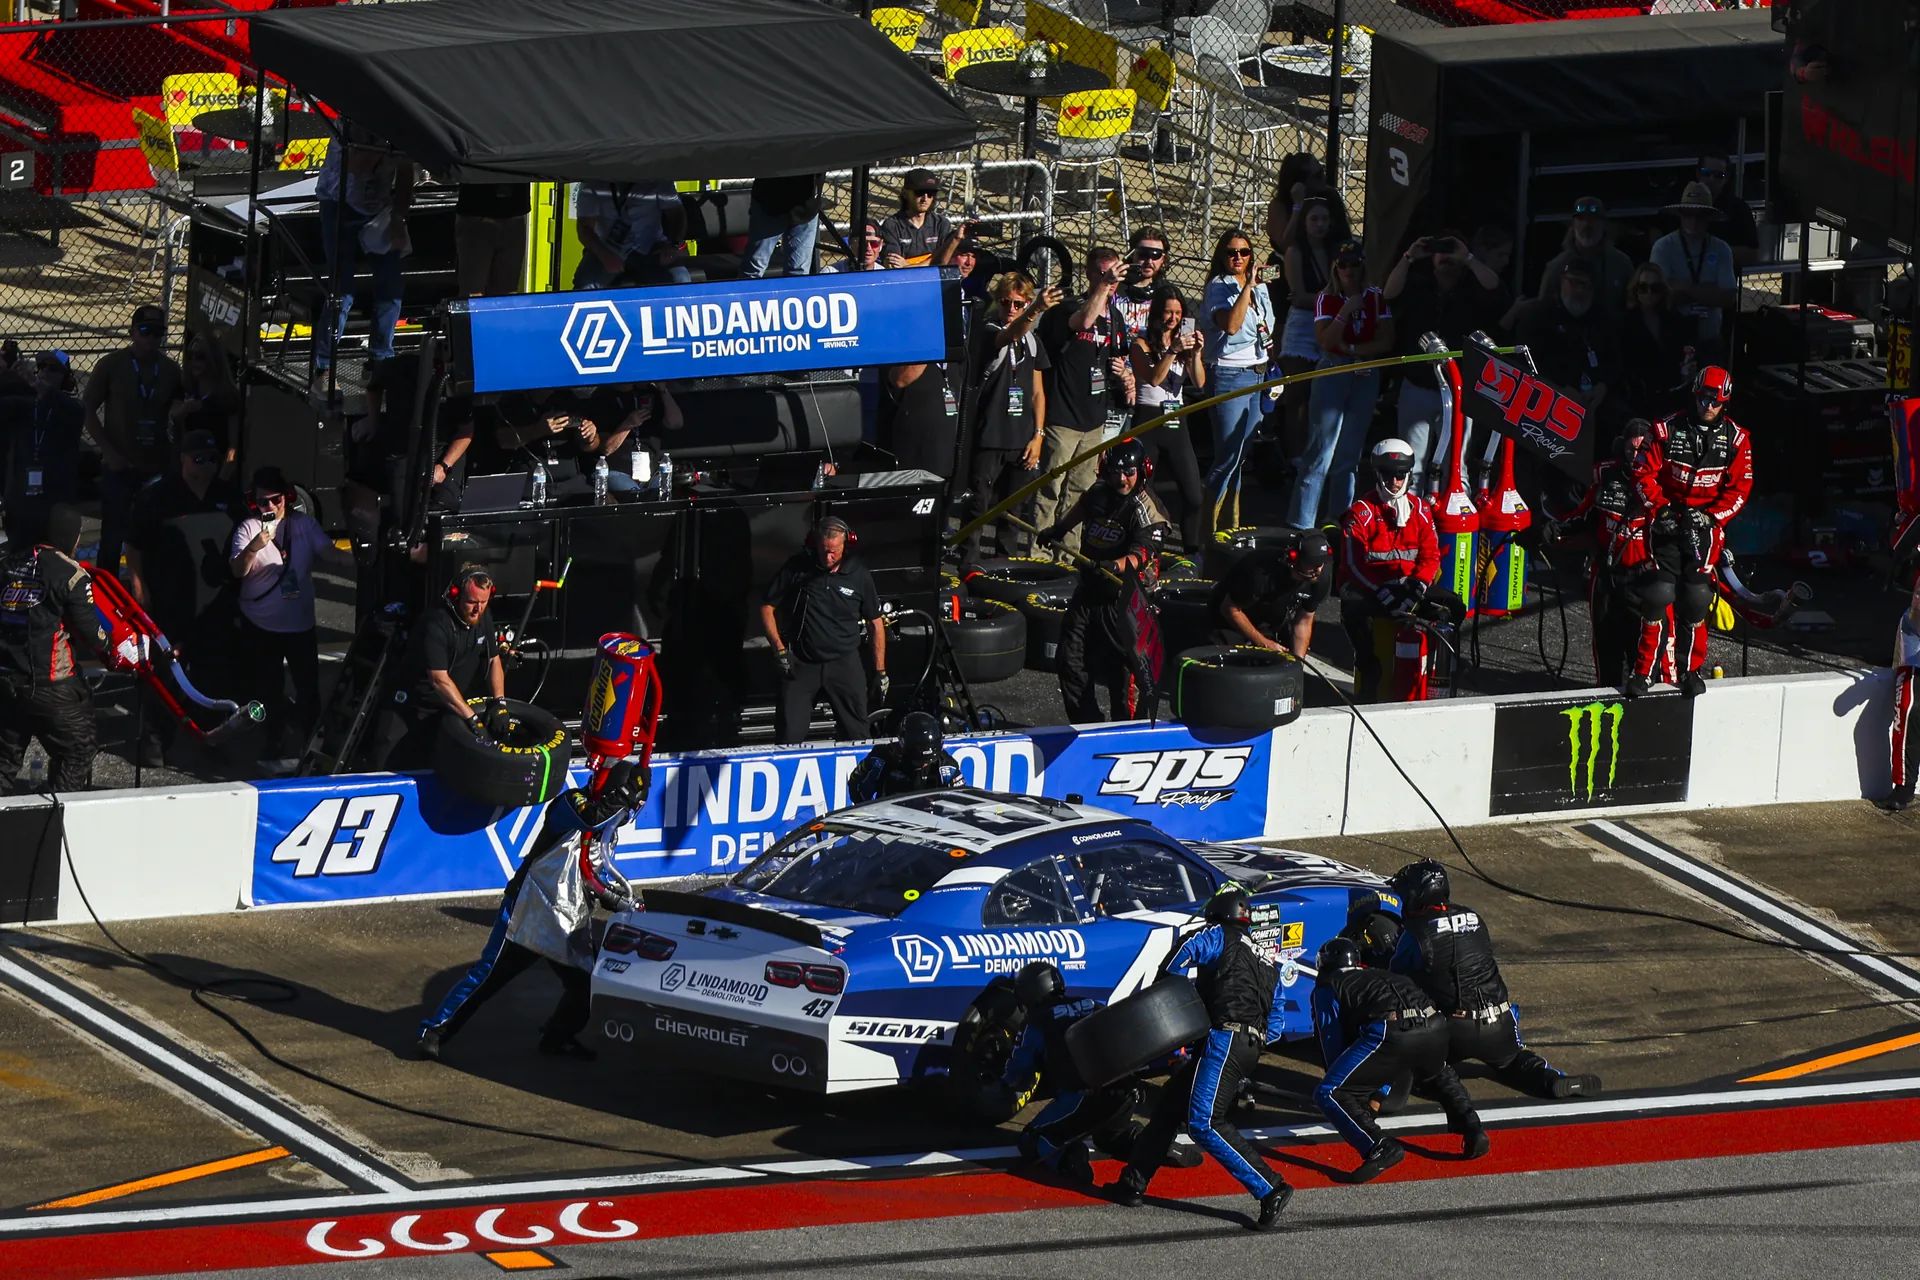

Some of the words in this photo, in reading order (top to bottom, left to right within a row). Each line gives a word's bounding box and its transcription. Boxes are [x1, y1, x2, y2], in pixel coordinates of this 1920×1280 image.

[10, 160, 25, 181] 2
[1389, 147, 1410, 186] 3
[640, 293, 859, 347] LINDAMOOD
[691, 333, 811, 359] DEMOLITION
[1474, 355, 1586, 442] sps
[1521, 422, 1575, 459] Racing
[912, 499, 934, 514] 43
[1096, 747, 1254, 804] sps
[1159, 788, 1234, 810] Racing
[271, 794, 402, 878] 43
[941, 929, 1086, 963] LINDAMOOD
[688, 971, 769, 1003] LINDAMOOD
[701, 988, 746, 1005] DEMOLITION
[801, 998, 834, 1019] 43
[655, 1018, 749, 1047] CHEVROLET
[845, 1021, 948, 1041] SIGMA
